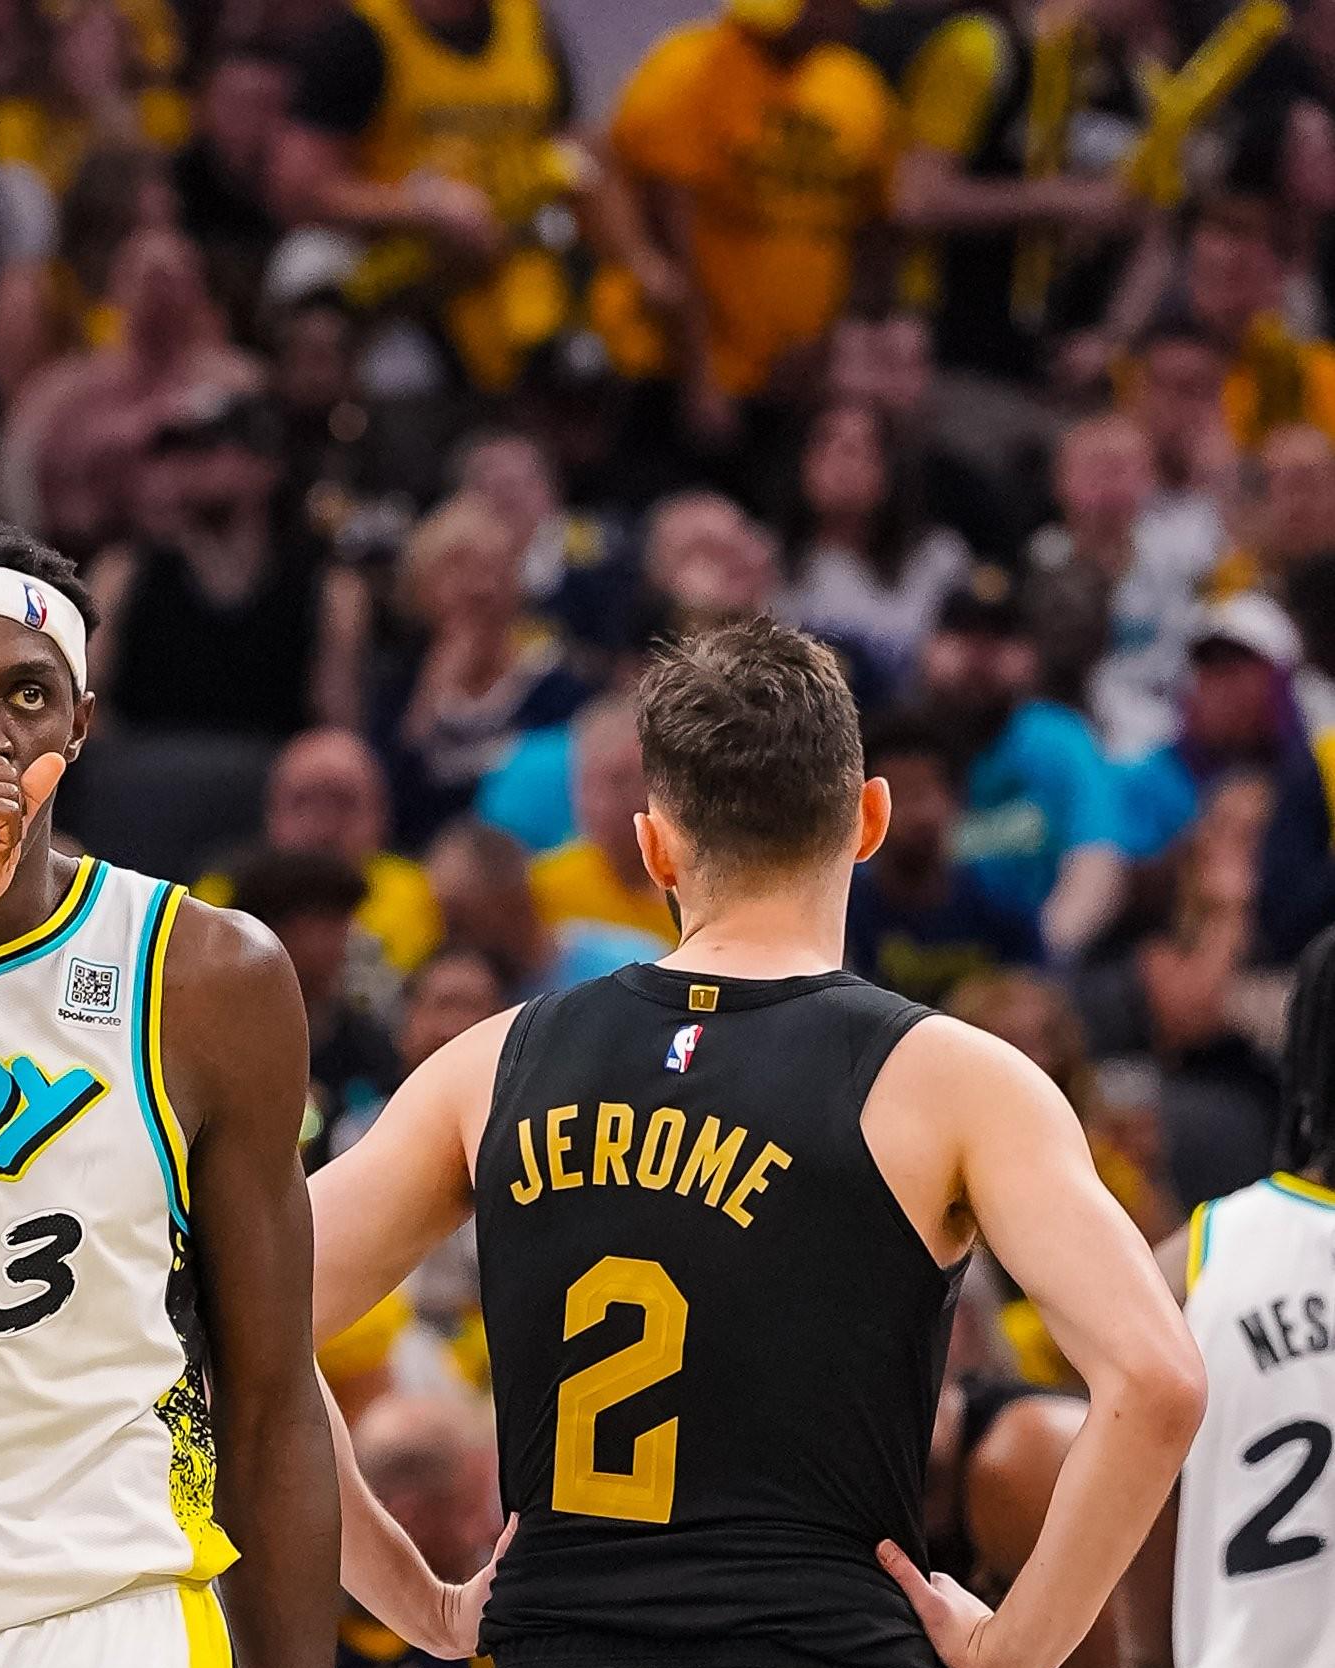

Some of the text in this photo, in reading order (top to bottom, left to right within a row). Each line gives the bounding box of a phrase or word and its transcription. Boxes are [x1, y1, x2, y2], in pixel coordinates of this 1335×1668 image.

[58, 1008, 121, 1026] spokenote
[510, 1102, 793, 1228] JEROME
[552, 1256, 689, 1523] 2
[1225, 1420, 1333, 1577] 2
